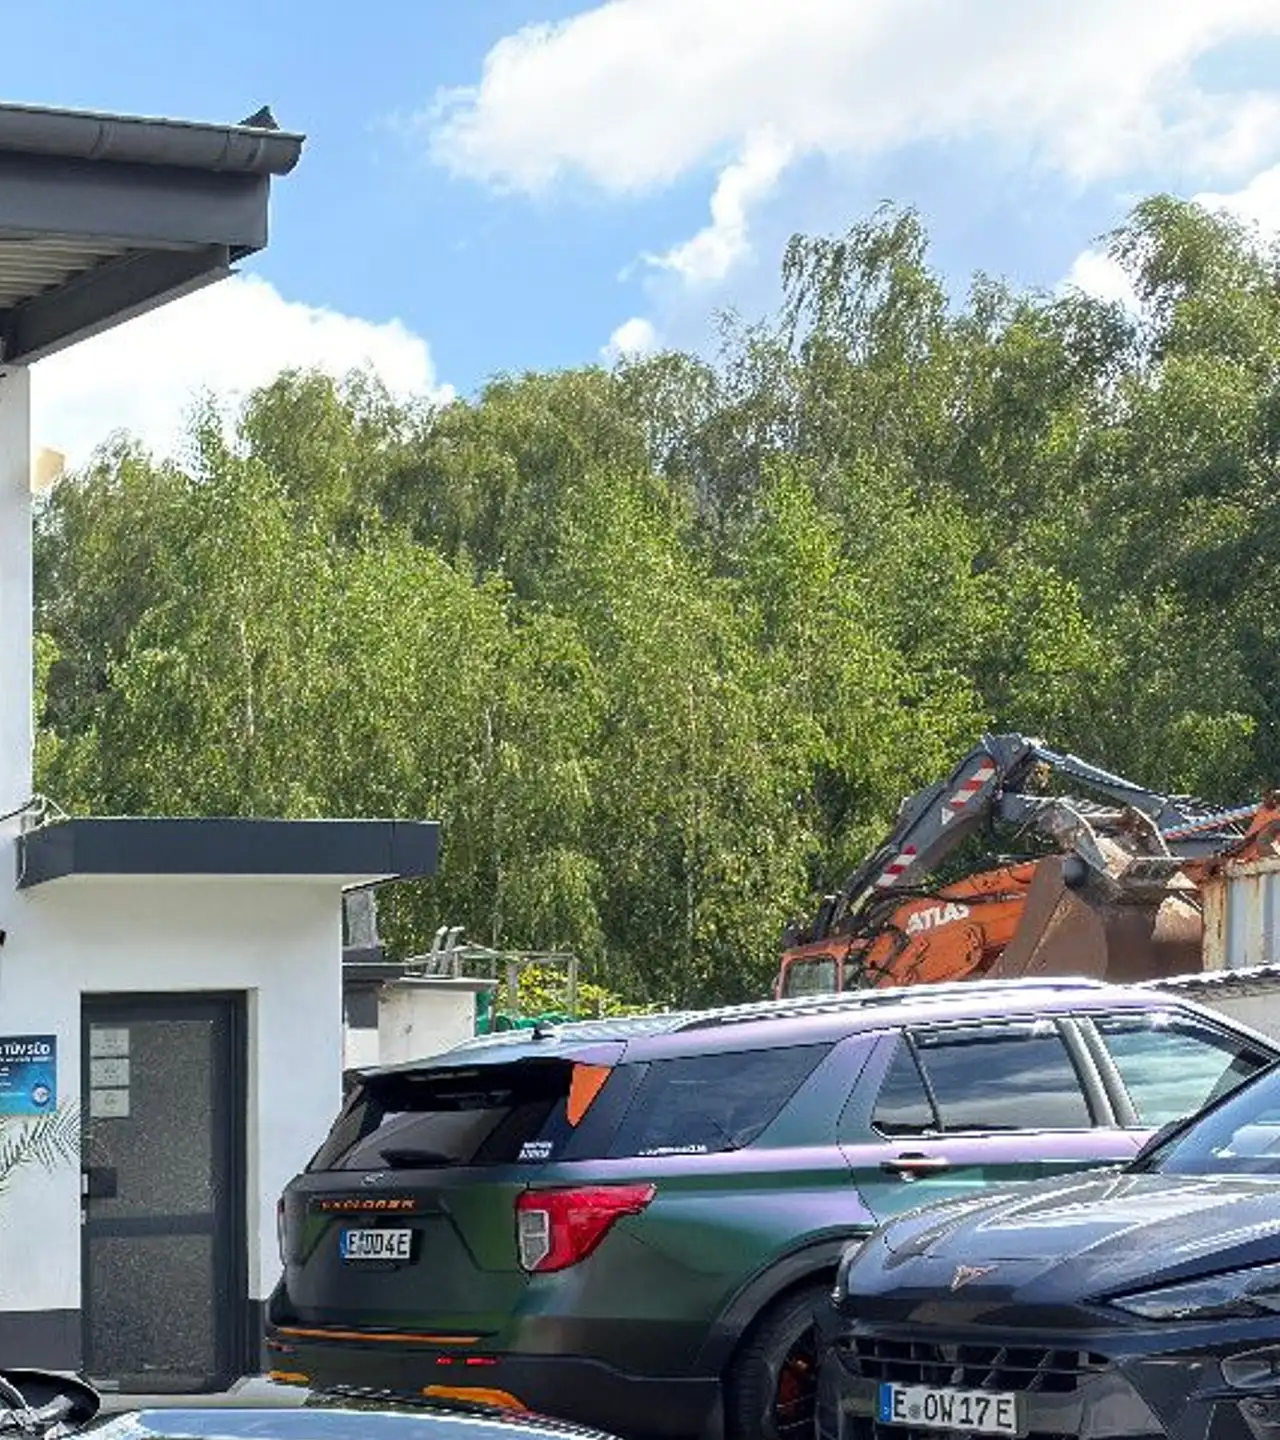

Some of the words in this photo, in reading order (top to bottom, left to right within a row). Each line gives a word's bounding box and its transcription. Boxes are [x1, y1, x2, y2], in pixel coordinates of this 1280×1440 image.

[905, 902, 969, 934] ATLAS
[3, 1042, 26, 1055] TÜV
[27, 1042, 50, 1055] SÜD
